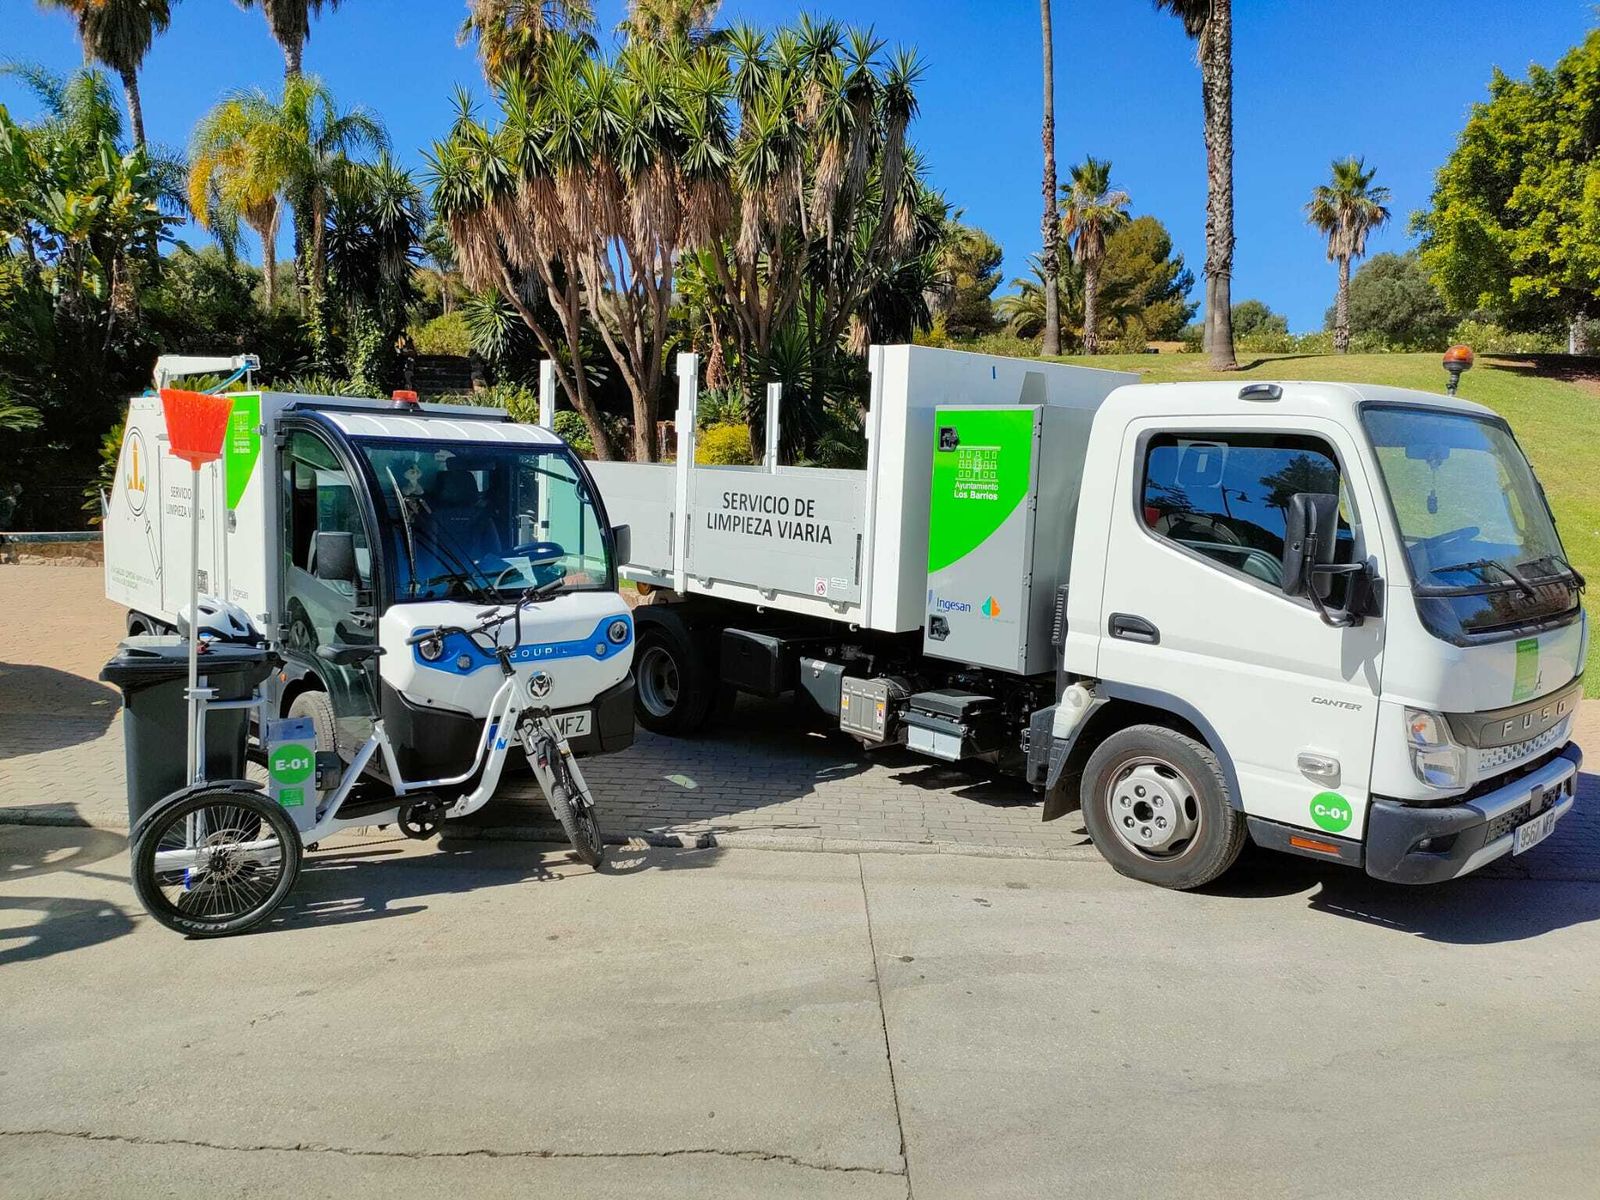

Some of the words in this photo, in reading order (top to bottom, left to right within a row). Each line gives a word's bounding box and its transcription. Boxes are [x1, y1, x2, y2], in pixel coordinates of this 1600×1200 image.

[954, 482, 998, 491] Ayuntamiento
[954, 490, 968, 499] Los
[970, 491, 998, 500] Barrios
[723, 492, 789, 515] SERVICIO
[795, 498, 815, 518] DE
[707, 512, 772, 537] LIMPIEZA
[778, 520, 832, 544] VIARIA
[936, 598, 971, 612] Ingesan
[1311, 696, 1362, 712] CANTER
[1502, 700, 1566, 738] FUSO
[275, 758, 308, 771] E-01
[1314, 804, 1349, 821] C-01
[173, 916, 228, 930] KENDA
